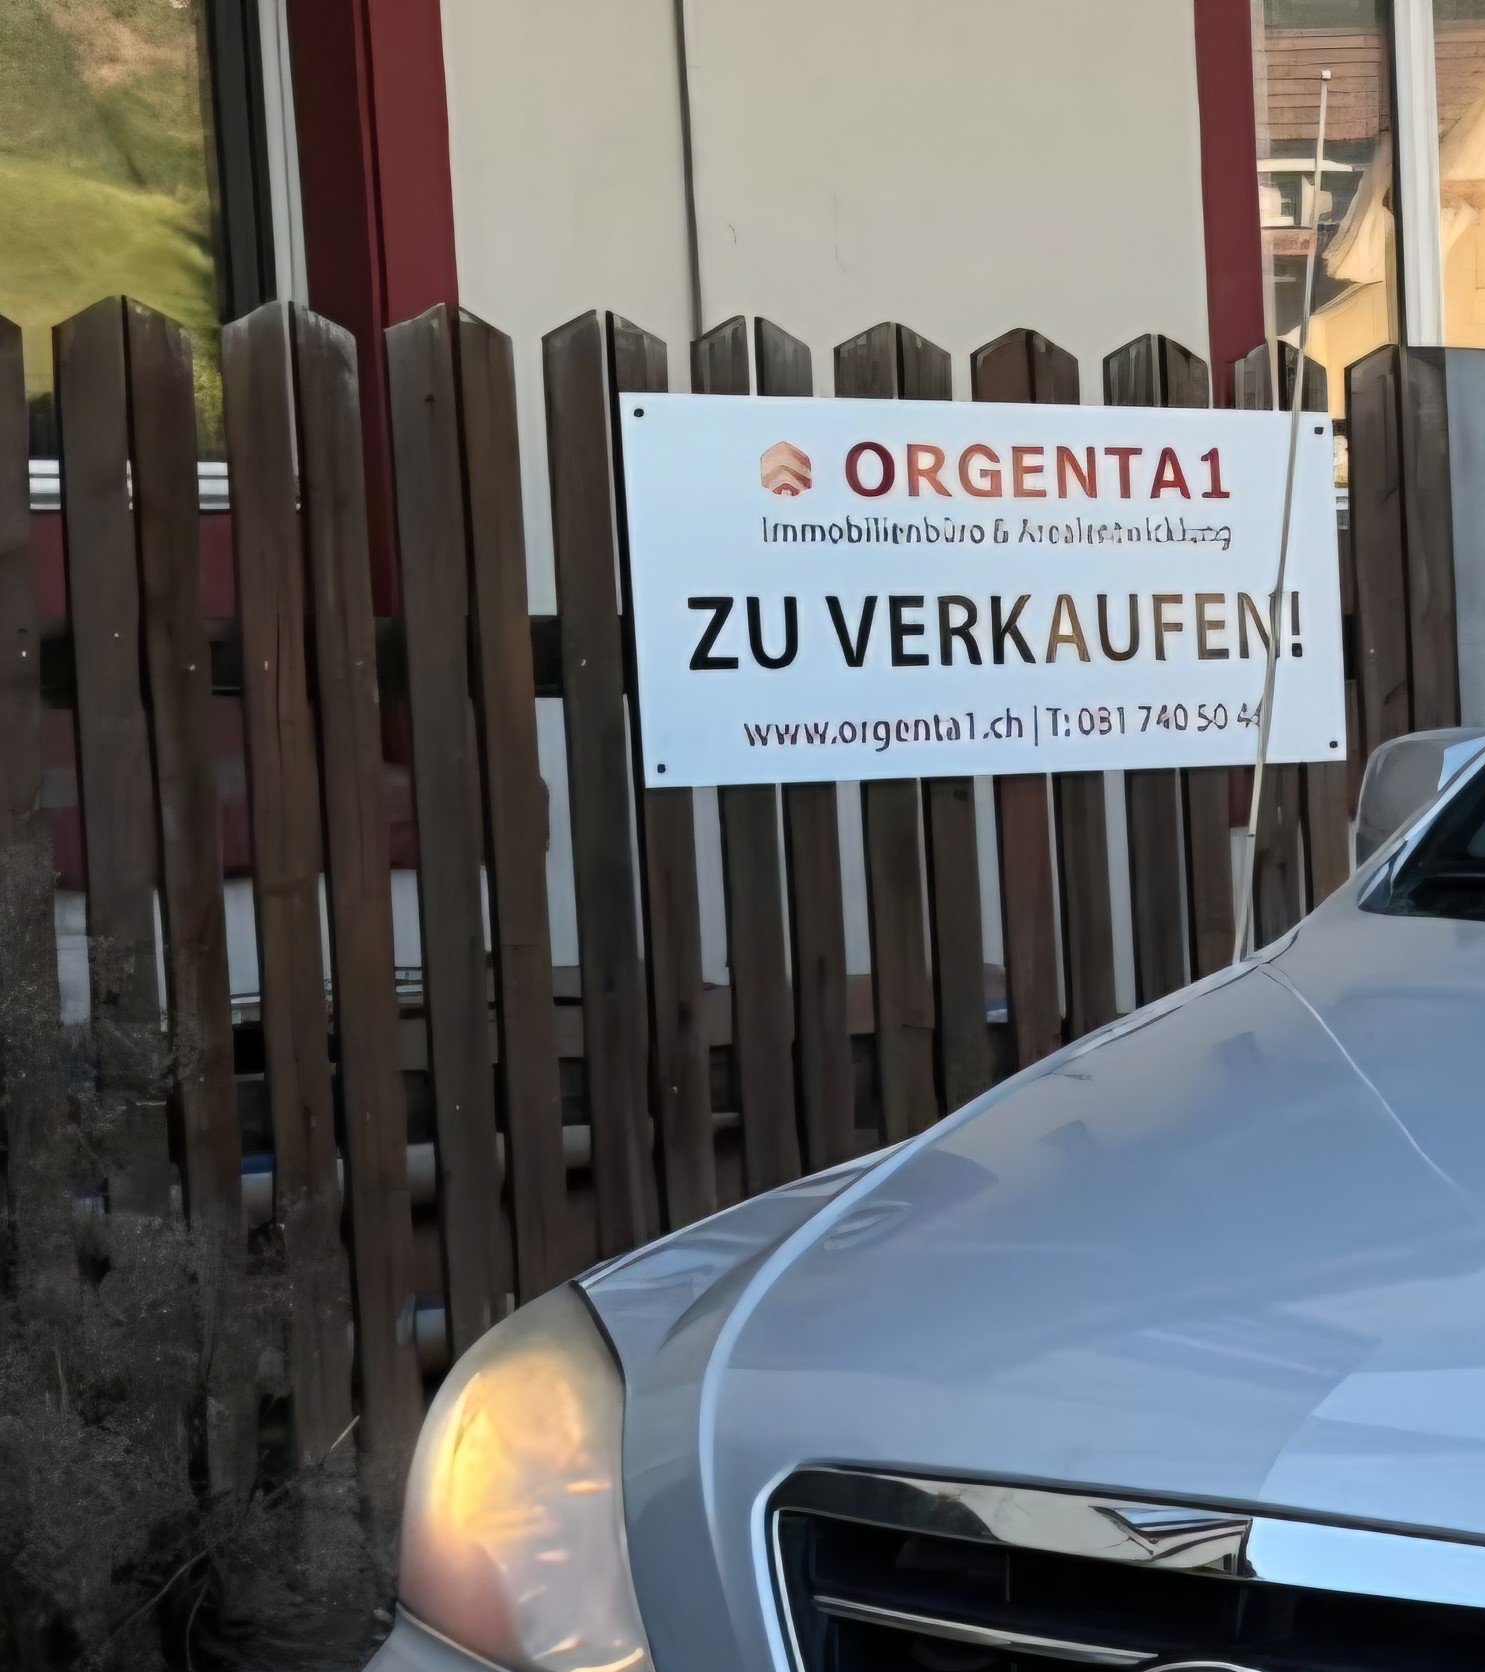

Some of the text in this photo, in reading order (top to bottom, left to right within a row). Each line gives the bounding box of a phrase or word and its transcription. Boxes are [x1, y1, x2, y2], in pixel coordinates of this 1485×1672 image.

[844, 441, 1231, 499] ORGENTA1
[687, 590, 1303, 671] ZU VERKAUFEN!
[1197, 703, 1228, 732] 50
